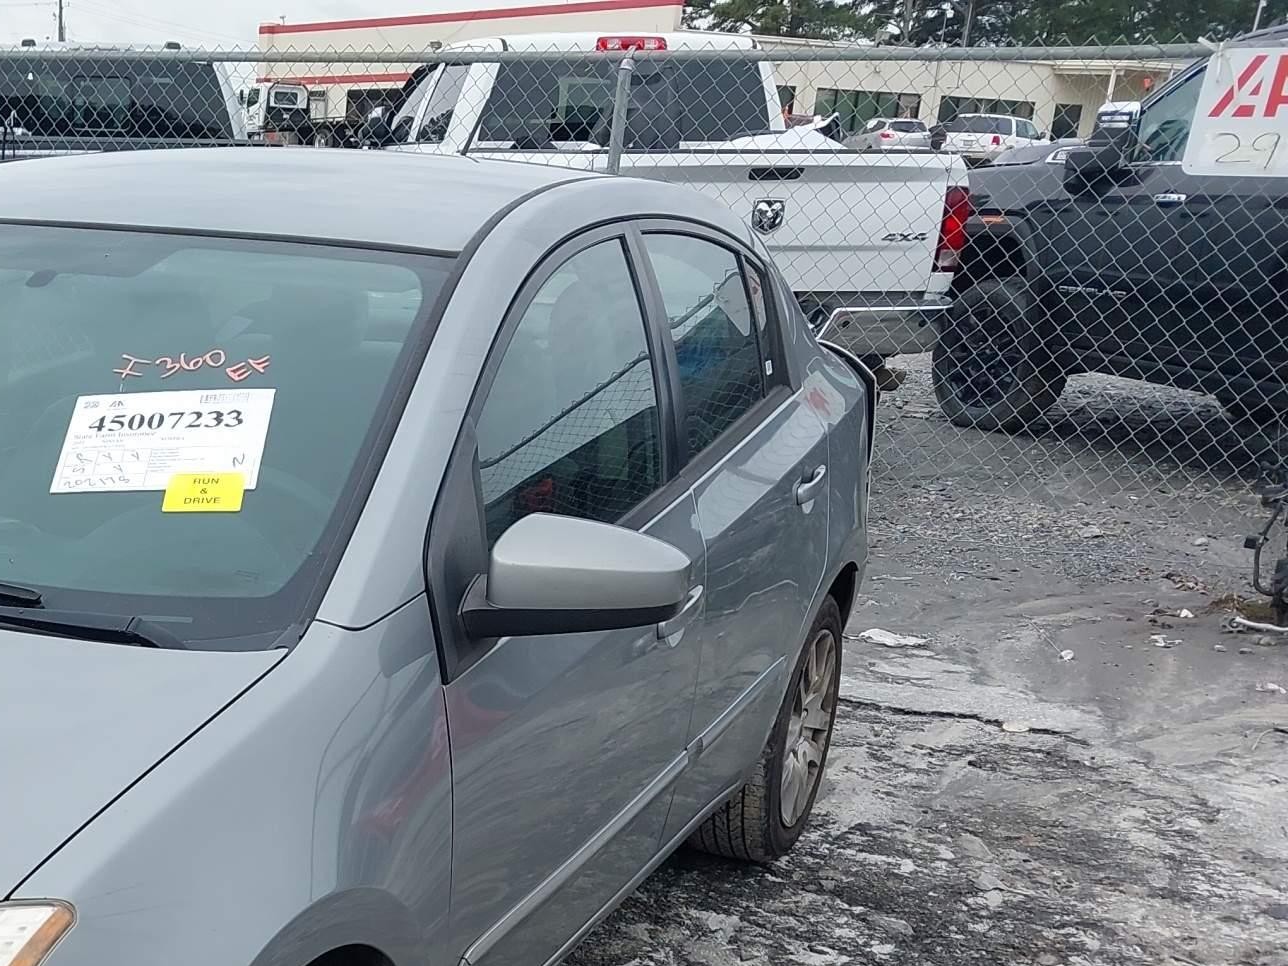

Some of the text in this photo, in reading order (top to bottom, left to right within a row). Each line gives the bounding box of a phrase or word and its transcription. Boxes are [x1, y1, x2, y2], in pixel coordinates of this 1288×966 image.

[1214, 132, 1281, 171] 29
[155, 349, 225, 378] 360
[88, 409, 244, 432] 45007233
[183, 496, 221, 504] DRIVE
